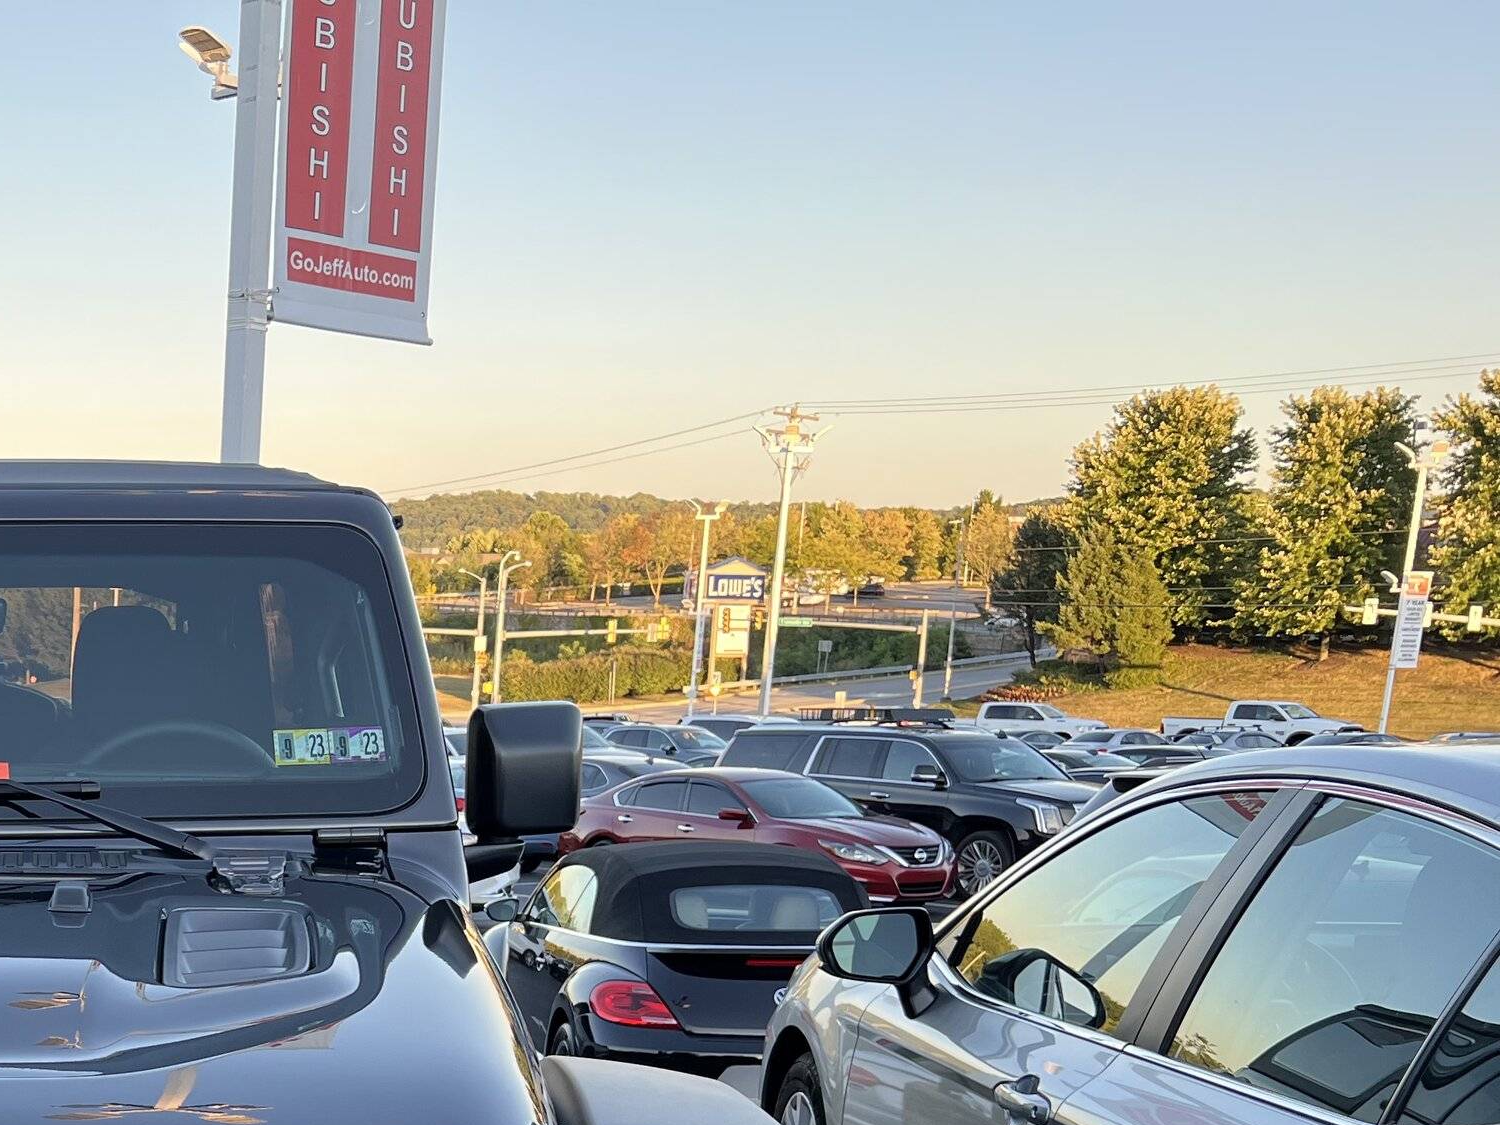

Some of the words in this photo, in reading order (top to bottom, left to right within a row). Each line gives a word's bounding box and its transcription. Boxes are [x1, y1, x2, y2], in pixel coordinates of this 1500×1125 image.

[308, 0, 337, 221] BISHI
[389, 0, 418, 237] UBISHI
[289, 250, 414, 291] GoJeffAuto.com
[708, 575, 764, 598] LOWE'S
[308, 733, 326, 758] 23
[362, 731, 380, 756] 23
